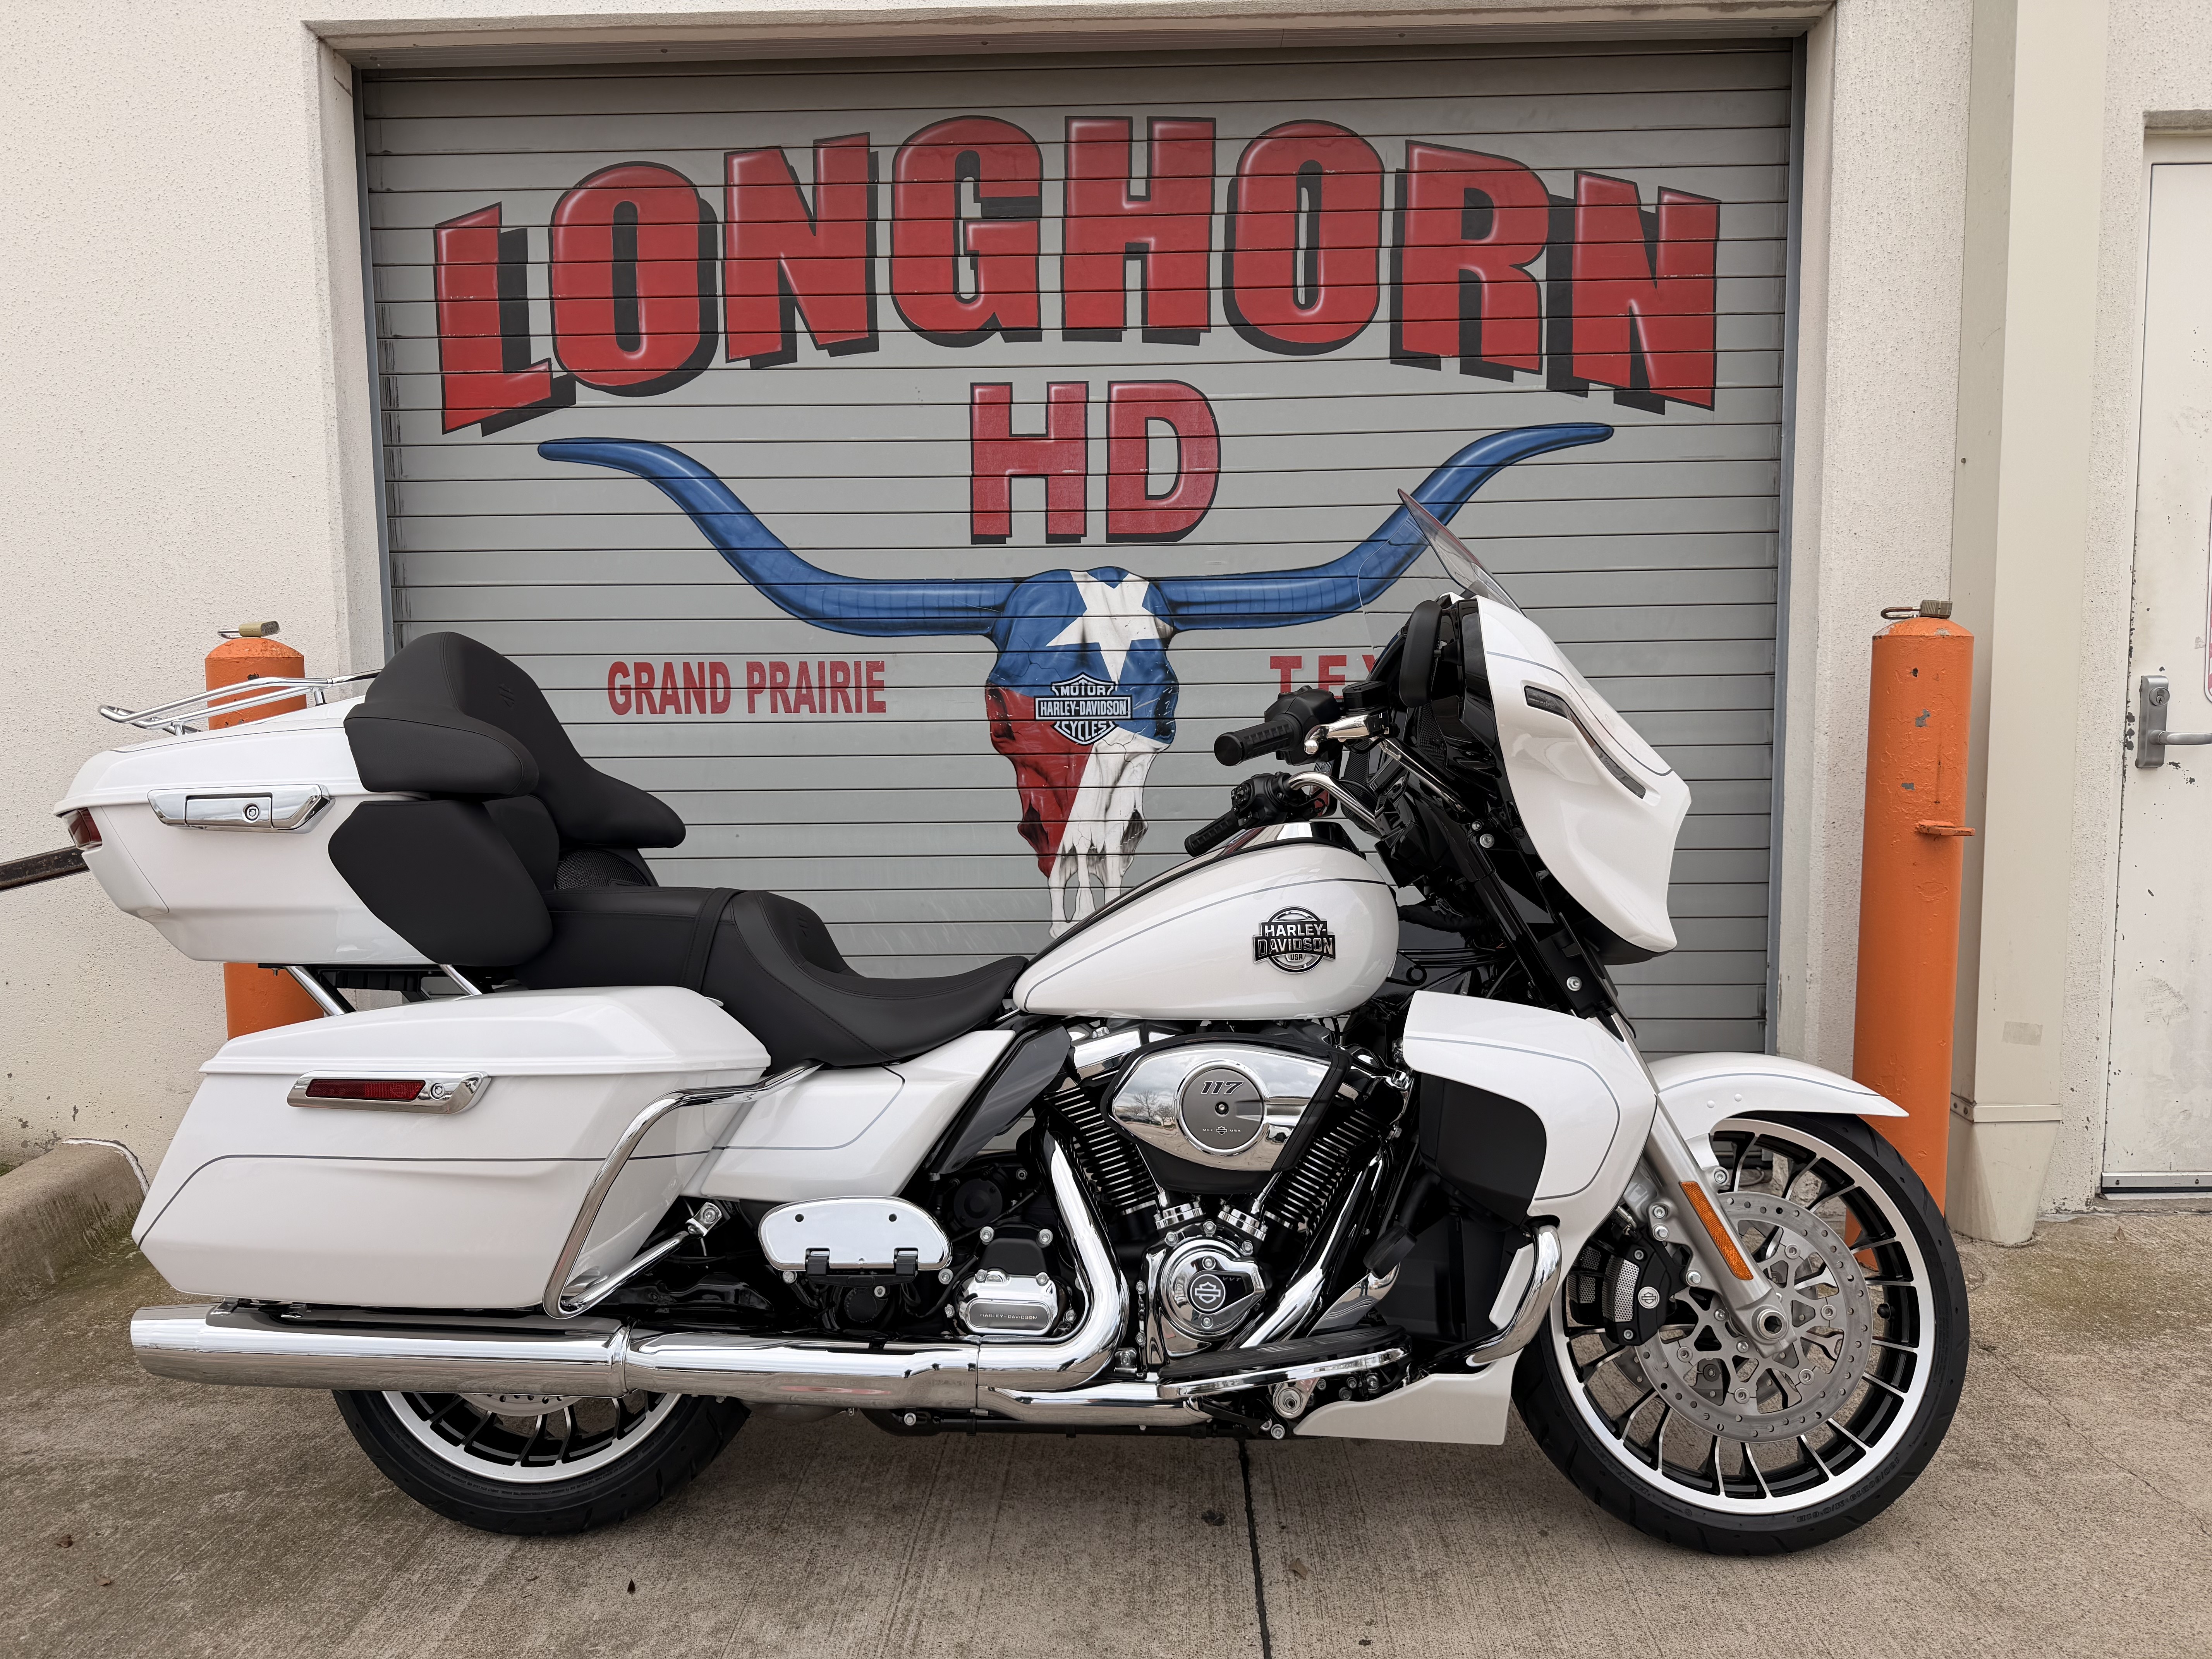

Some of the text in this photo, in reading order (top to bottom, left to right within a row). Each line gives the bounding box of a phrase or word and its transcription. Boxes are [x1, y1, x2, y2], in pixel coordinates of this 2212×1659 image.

[434, 116, 1722, 436] LONGHORN
[970, 380, 1221, 544] HD
[1270, 654, 1377, 699] TE
[608, 660, 886, 715] GRAND PRAIRIE
[1060, 679, 1106, 696] MOTOR
[1040, 700, 1127, 716] HARLEY-DAVIDSON
[1061, 721, 1107, 741] CYCLES
[1264, 924, 1326, 937] HARLEY-
[1257, 938, 1333, 958] DAVIDSON
[1200, 1081, 1244, 1095] 117
